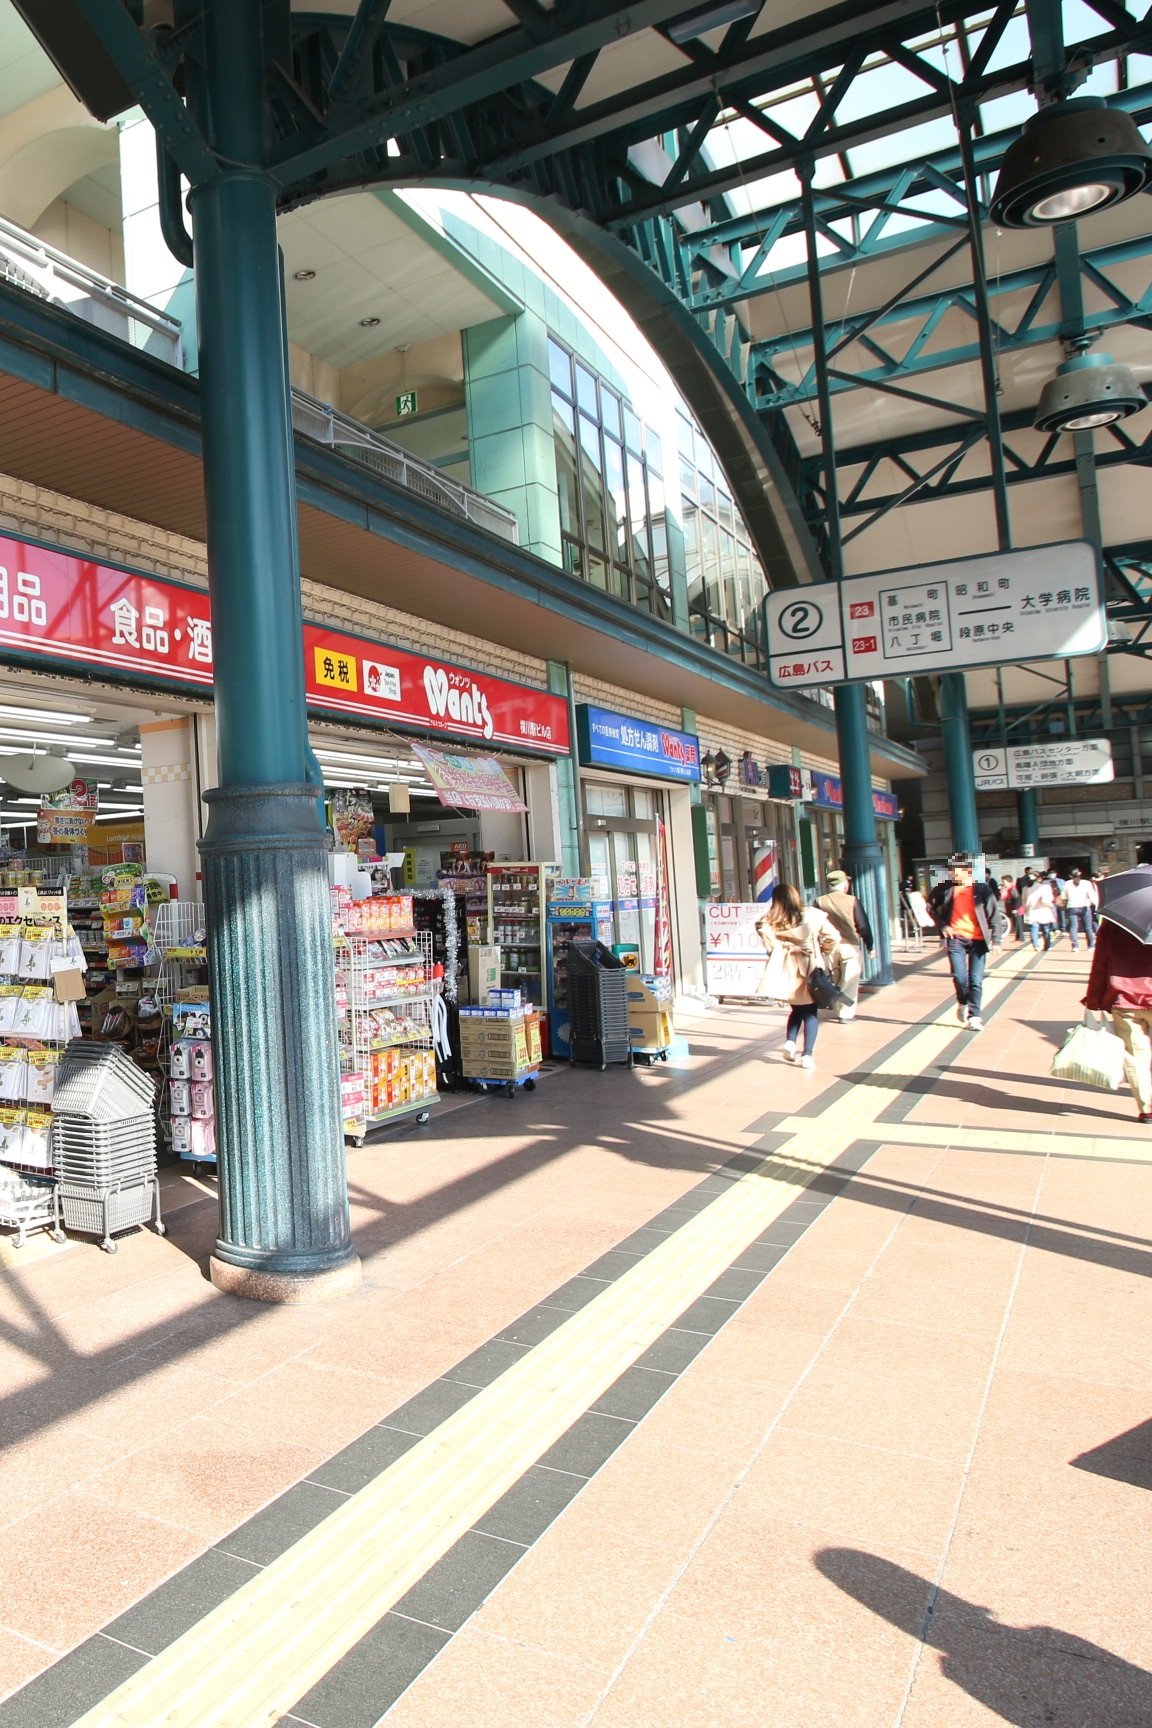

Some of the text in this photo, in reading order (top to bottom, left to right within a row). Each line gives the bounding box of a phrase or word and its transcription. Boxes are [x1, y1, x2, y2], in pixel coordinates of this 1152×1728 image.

[1020, 587, 1090, 610] 大学病院
[854, 605, 869, 617] 23
[888, 609, 941, 627] 市民病院
[109, 596, 214, 664] 食品・酒
[890, 630, 943, 649] 八丁堀
[959, 621, 1015, 639] 段原中央
[853, 638, 875, 652] 23-1
[323, 656, 350, 684] 免税
[778, 659, 834, 680] 広島バス
[449, 672, 470, 689] ウォンツ
[423, 665, 494, 740] Wants
[519, 719, 552, 740] 横川駅ビル店
[709, 906, 741, 919] CUT
